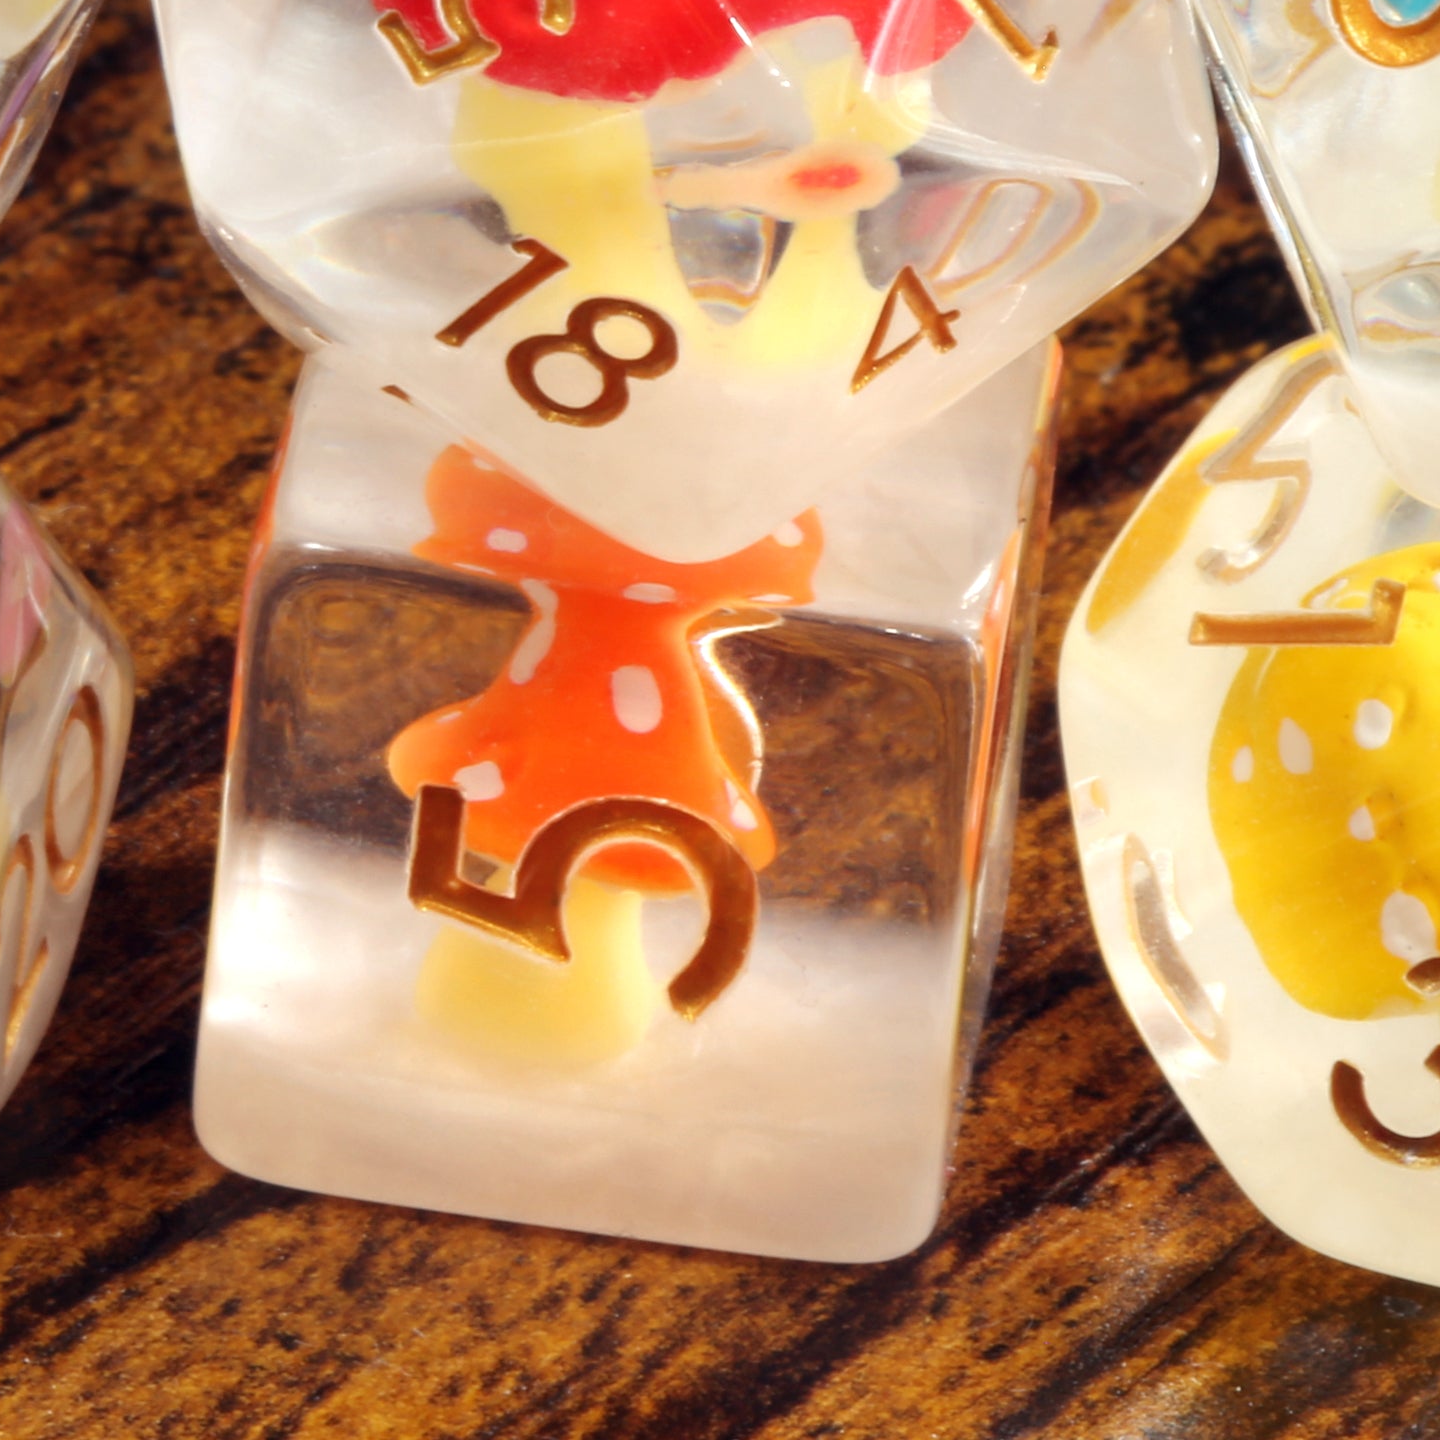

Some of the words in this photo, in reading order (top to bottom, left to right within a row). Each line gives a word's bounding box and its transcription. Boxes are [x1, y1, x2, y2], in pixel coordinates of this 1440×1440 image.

[435, 235, 679, 429] 18
[849, 264, 961, 397] 4
[406, 782, 759, 1024] 5
